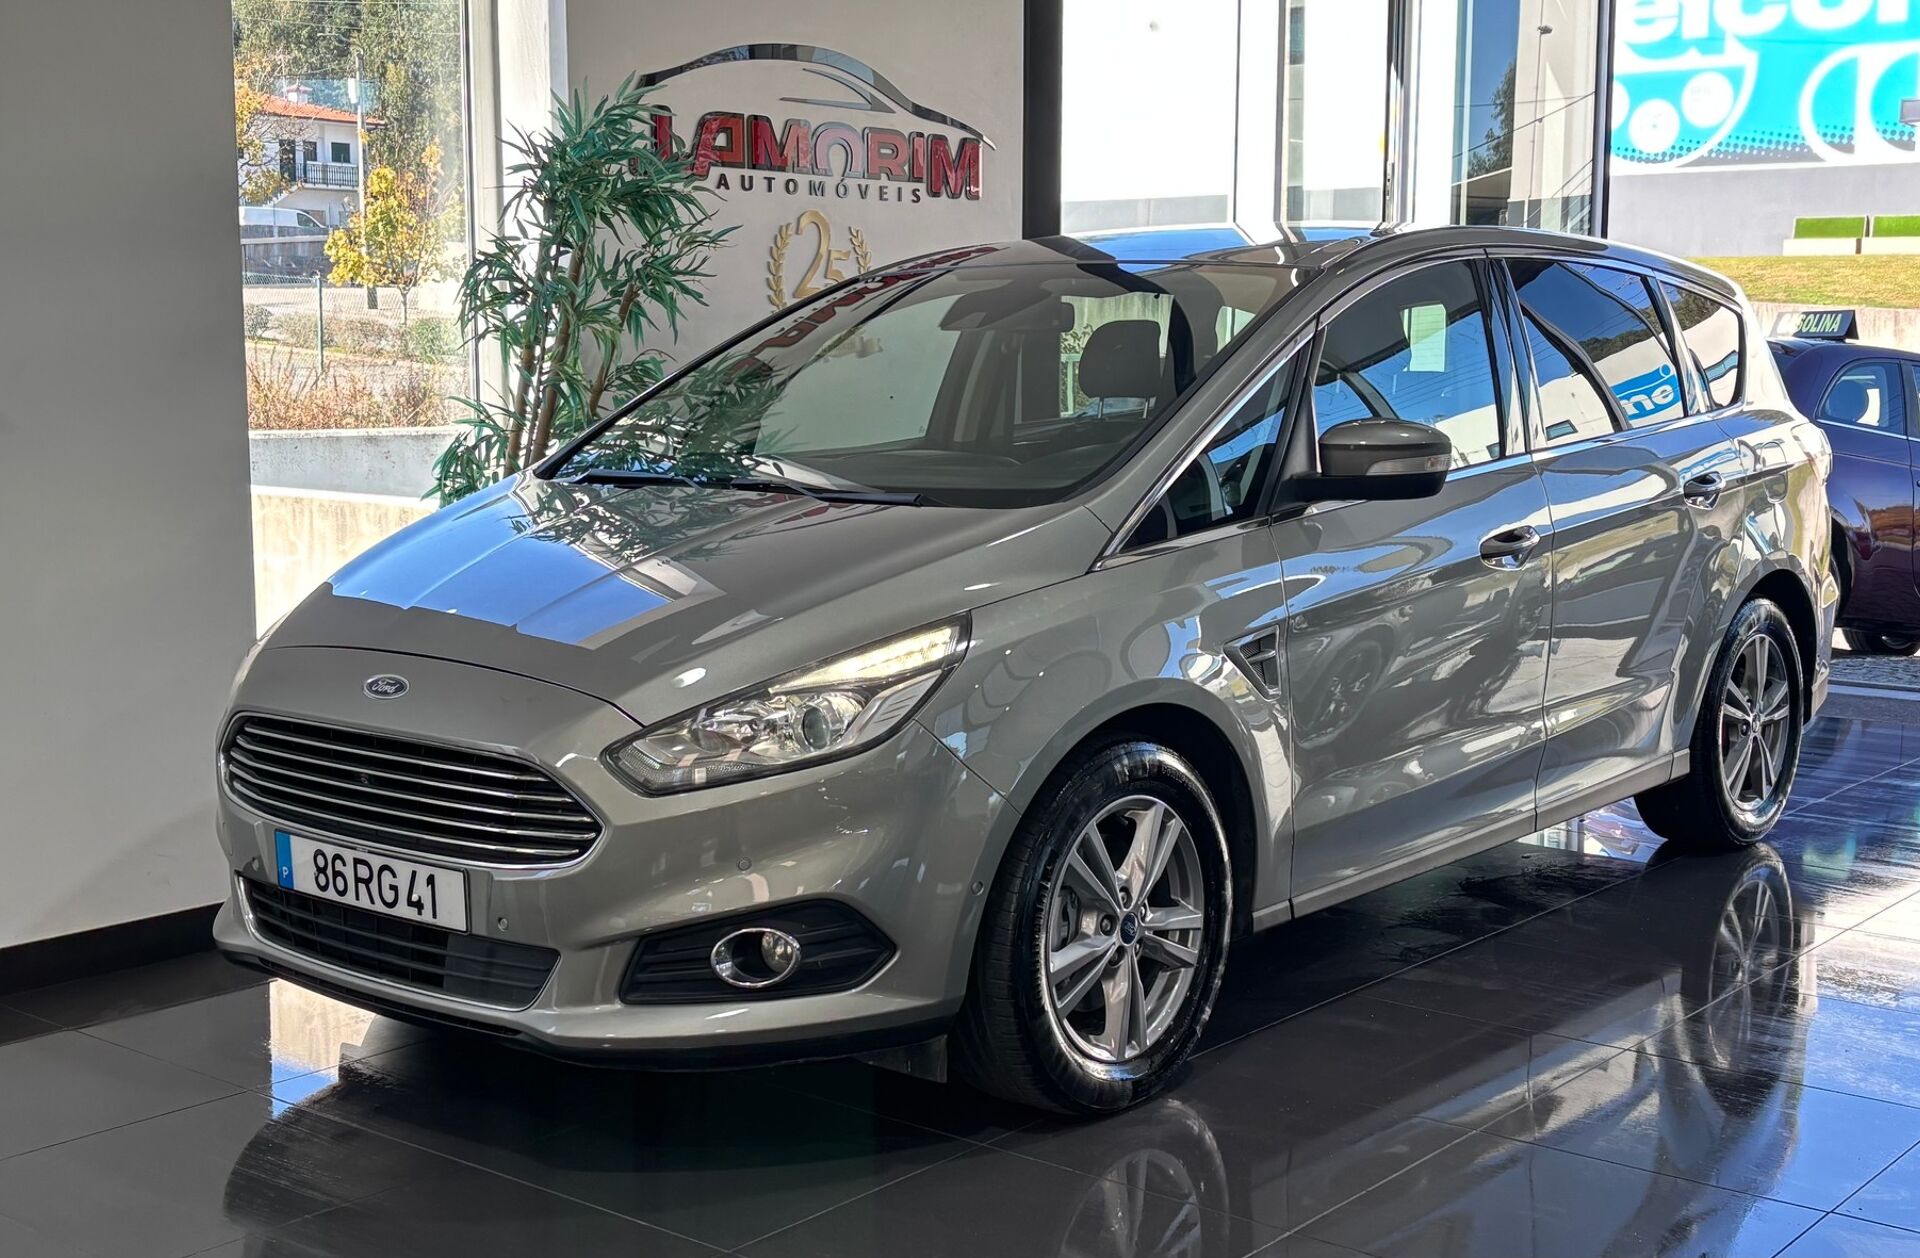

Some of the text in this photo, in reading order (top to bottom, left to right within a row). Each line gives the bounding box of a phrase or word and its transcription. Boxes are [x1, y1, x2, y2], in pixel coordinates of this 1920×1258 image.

[716, 173, 921, 203] AUTOMÓVEIS
[794, 209, 851, 298] 25
[1777, 312, 1842, 333] SOLINA
[281, 866, 289, 879] P
